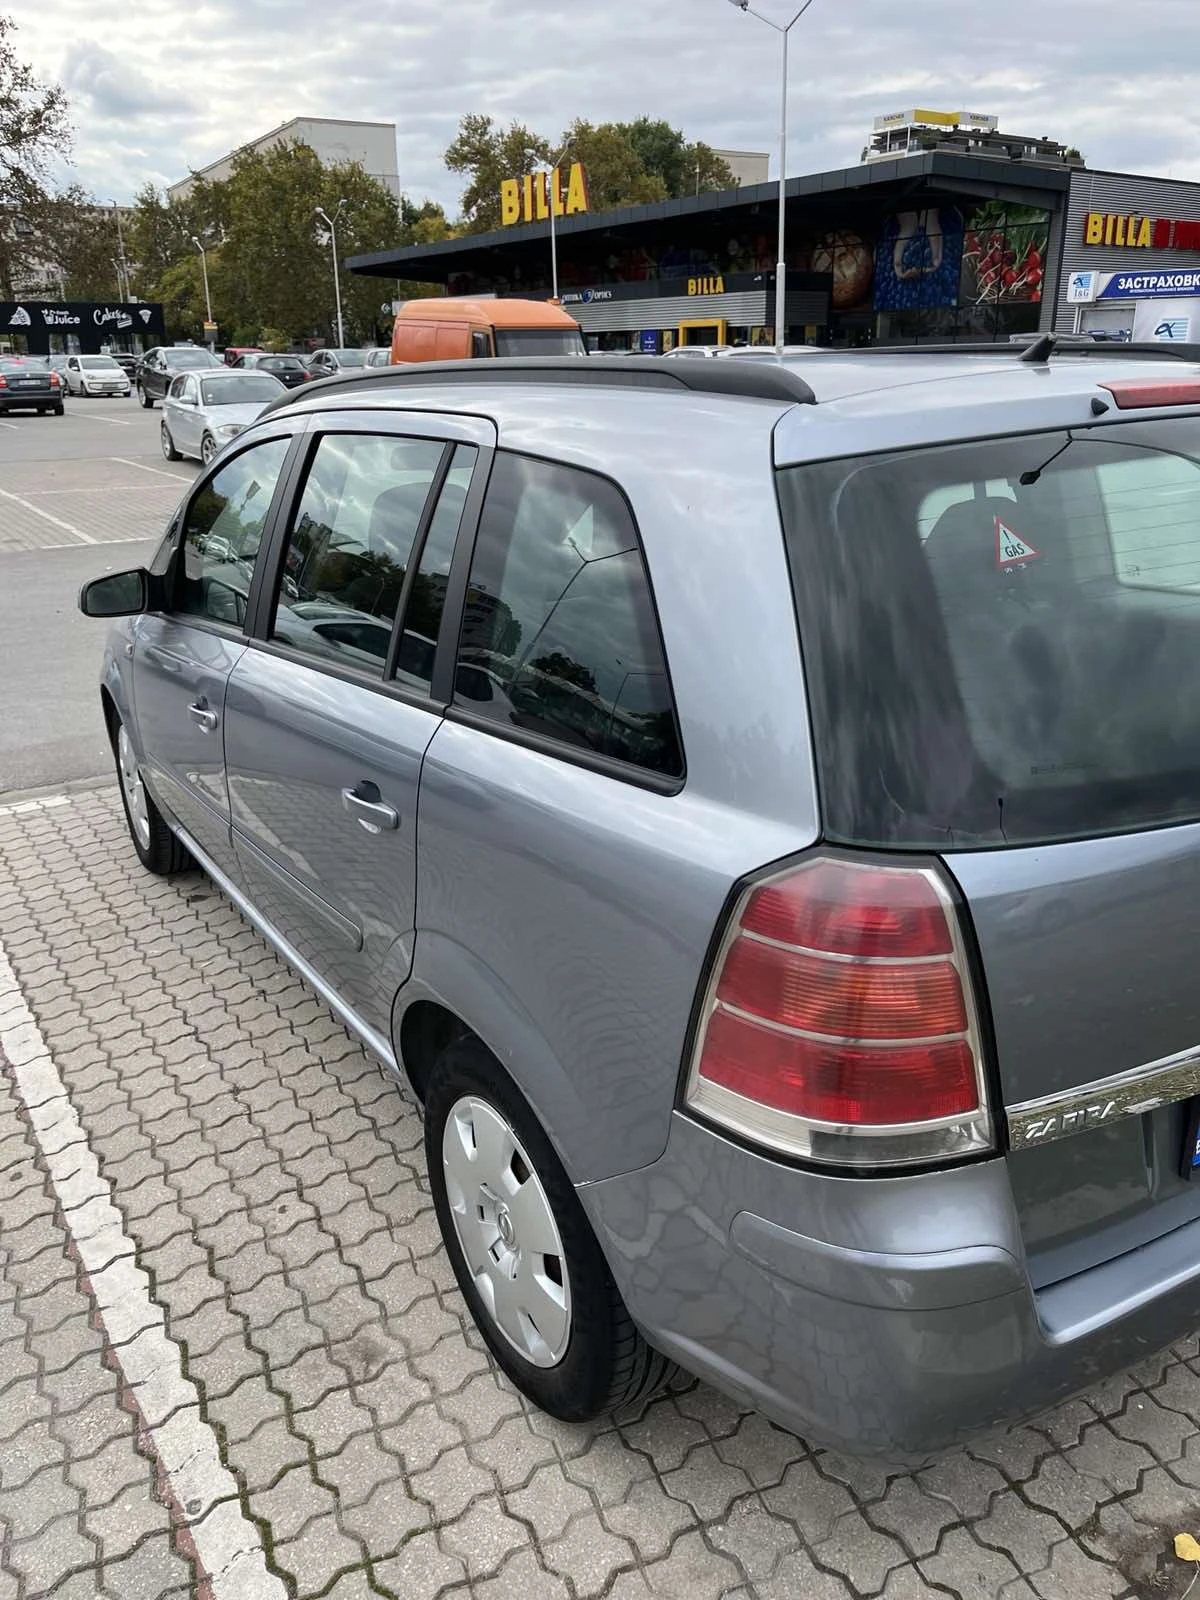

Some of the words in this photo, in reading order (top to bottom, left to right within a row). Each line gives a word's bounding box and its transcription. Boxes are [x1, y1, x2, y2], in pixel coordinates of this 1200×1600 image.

[501, 162, 589, 226] BILLA
[1085, 213, 1151, 248] BILLA
[687, 276, 724, 296] BILLA
[54, 314, 80, 324] Juice
[93, 307, 121, 325] Cakes
[1005, 543, 1025, 558] GAS
